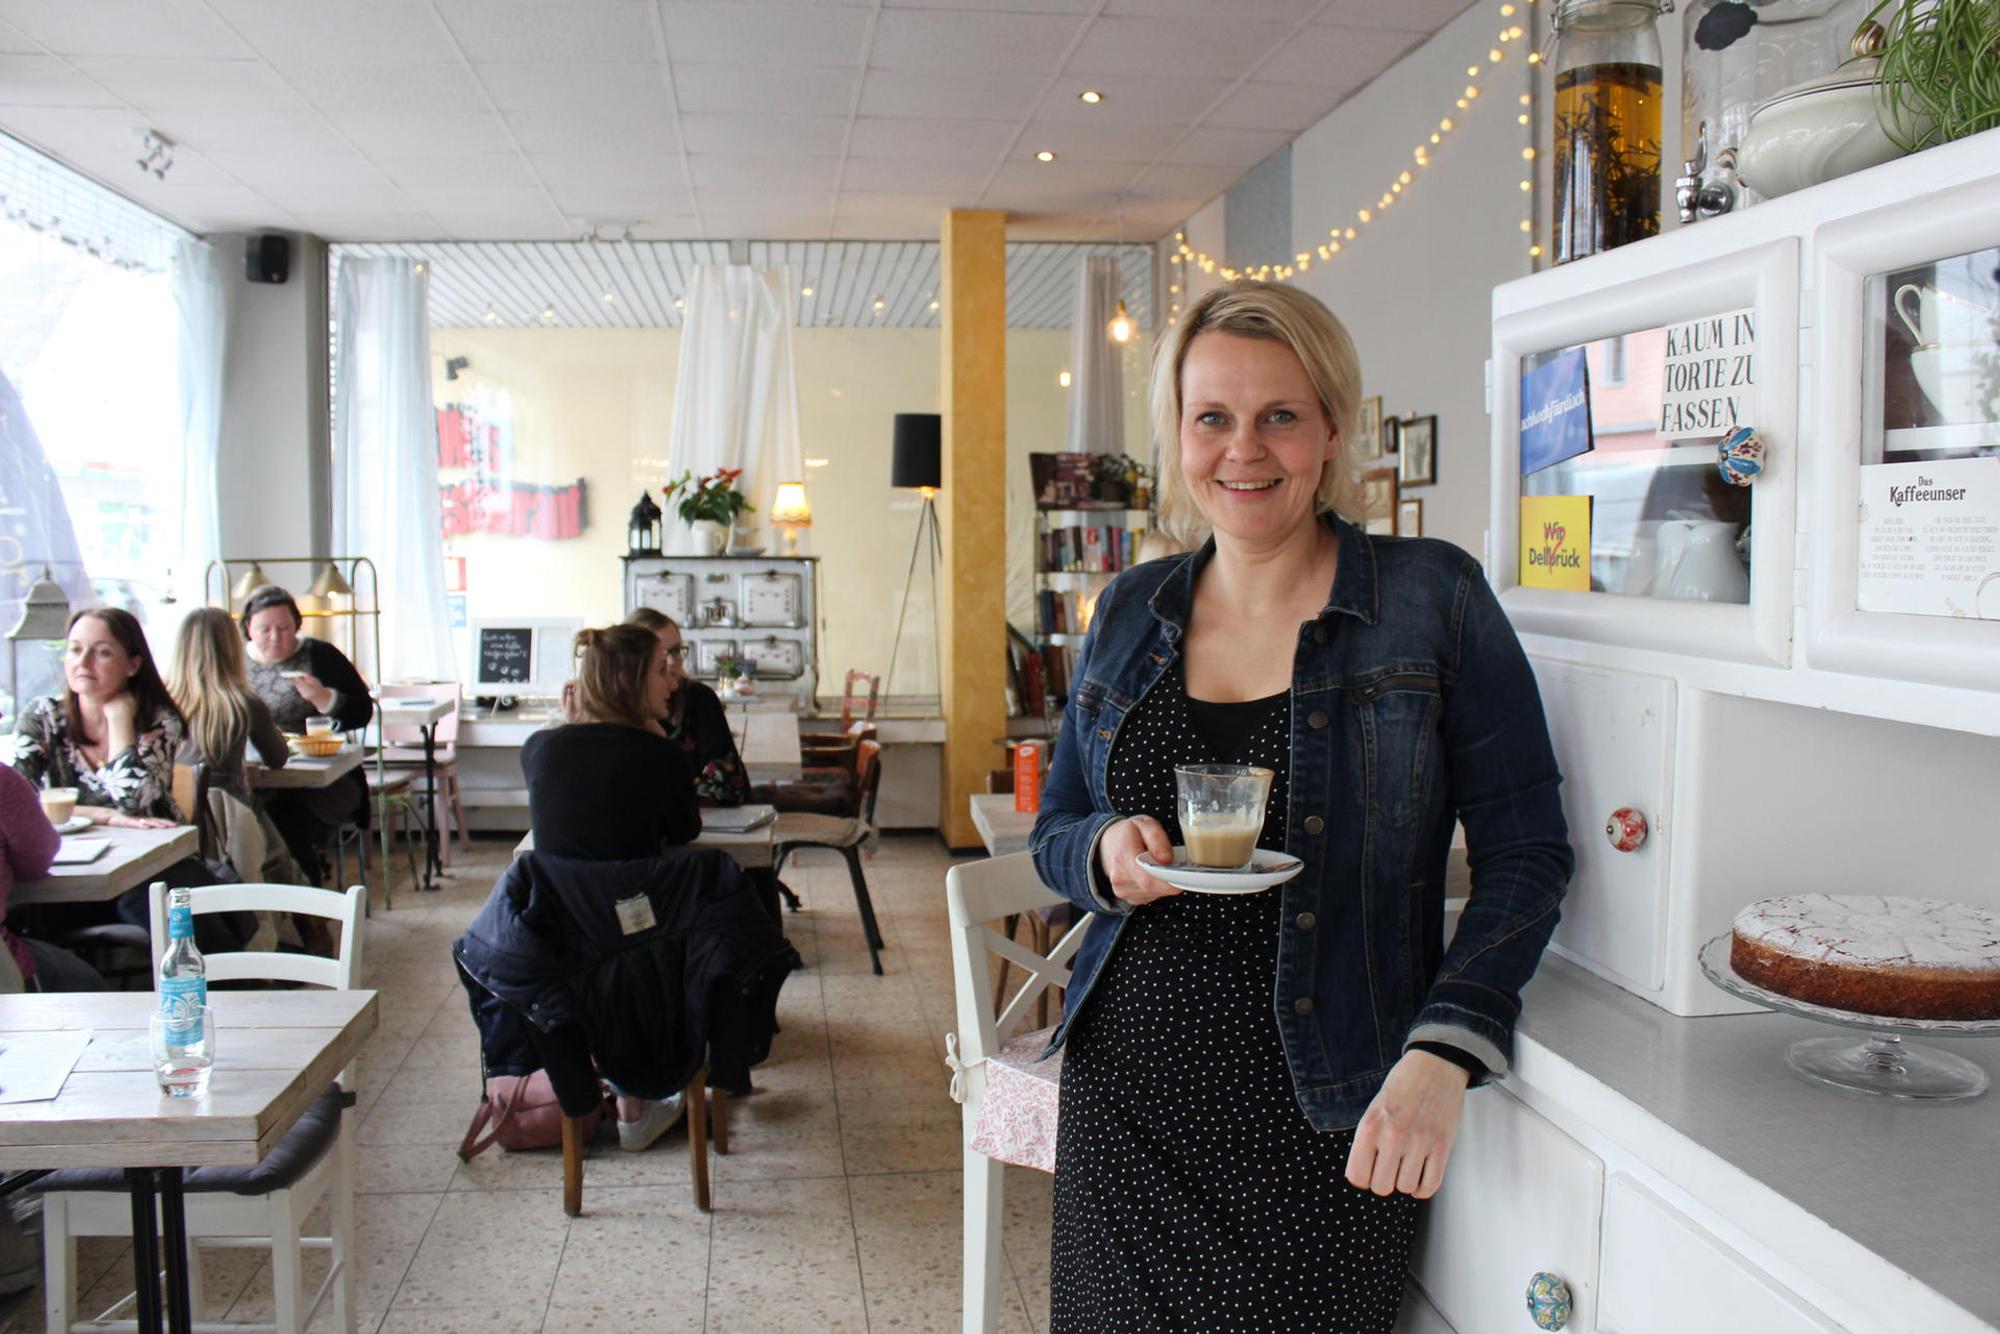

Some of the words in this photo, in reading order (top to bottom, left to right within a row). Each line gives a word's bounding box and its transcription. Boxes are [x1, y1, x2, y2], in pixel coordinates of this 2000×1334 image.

[1665, 319, 1724, 358] KAUM
[1664, 358, 1727, 393] TORTE
[1659, 396, 1741, 432] FASSEN
[1918, 476, 1933, 486] Das
[1890, 486, 1966, 507] Kaffeeunser
[1528, 547, 1581, 568] Dellbrück
